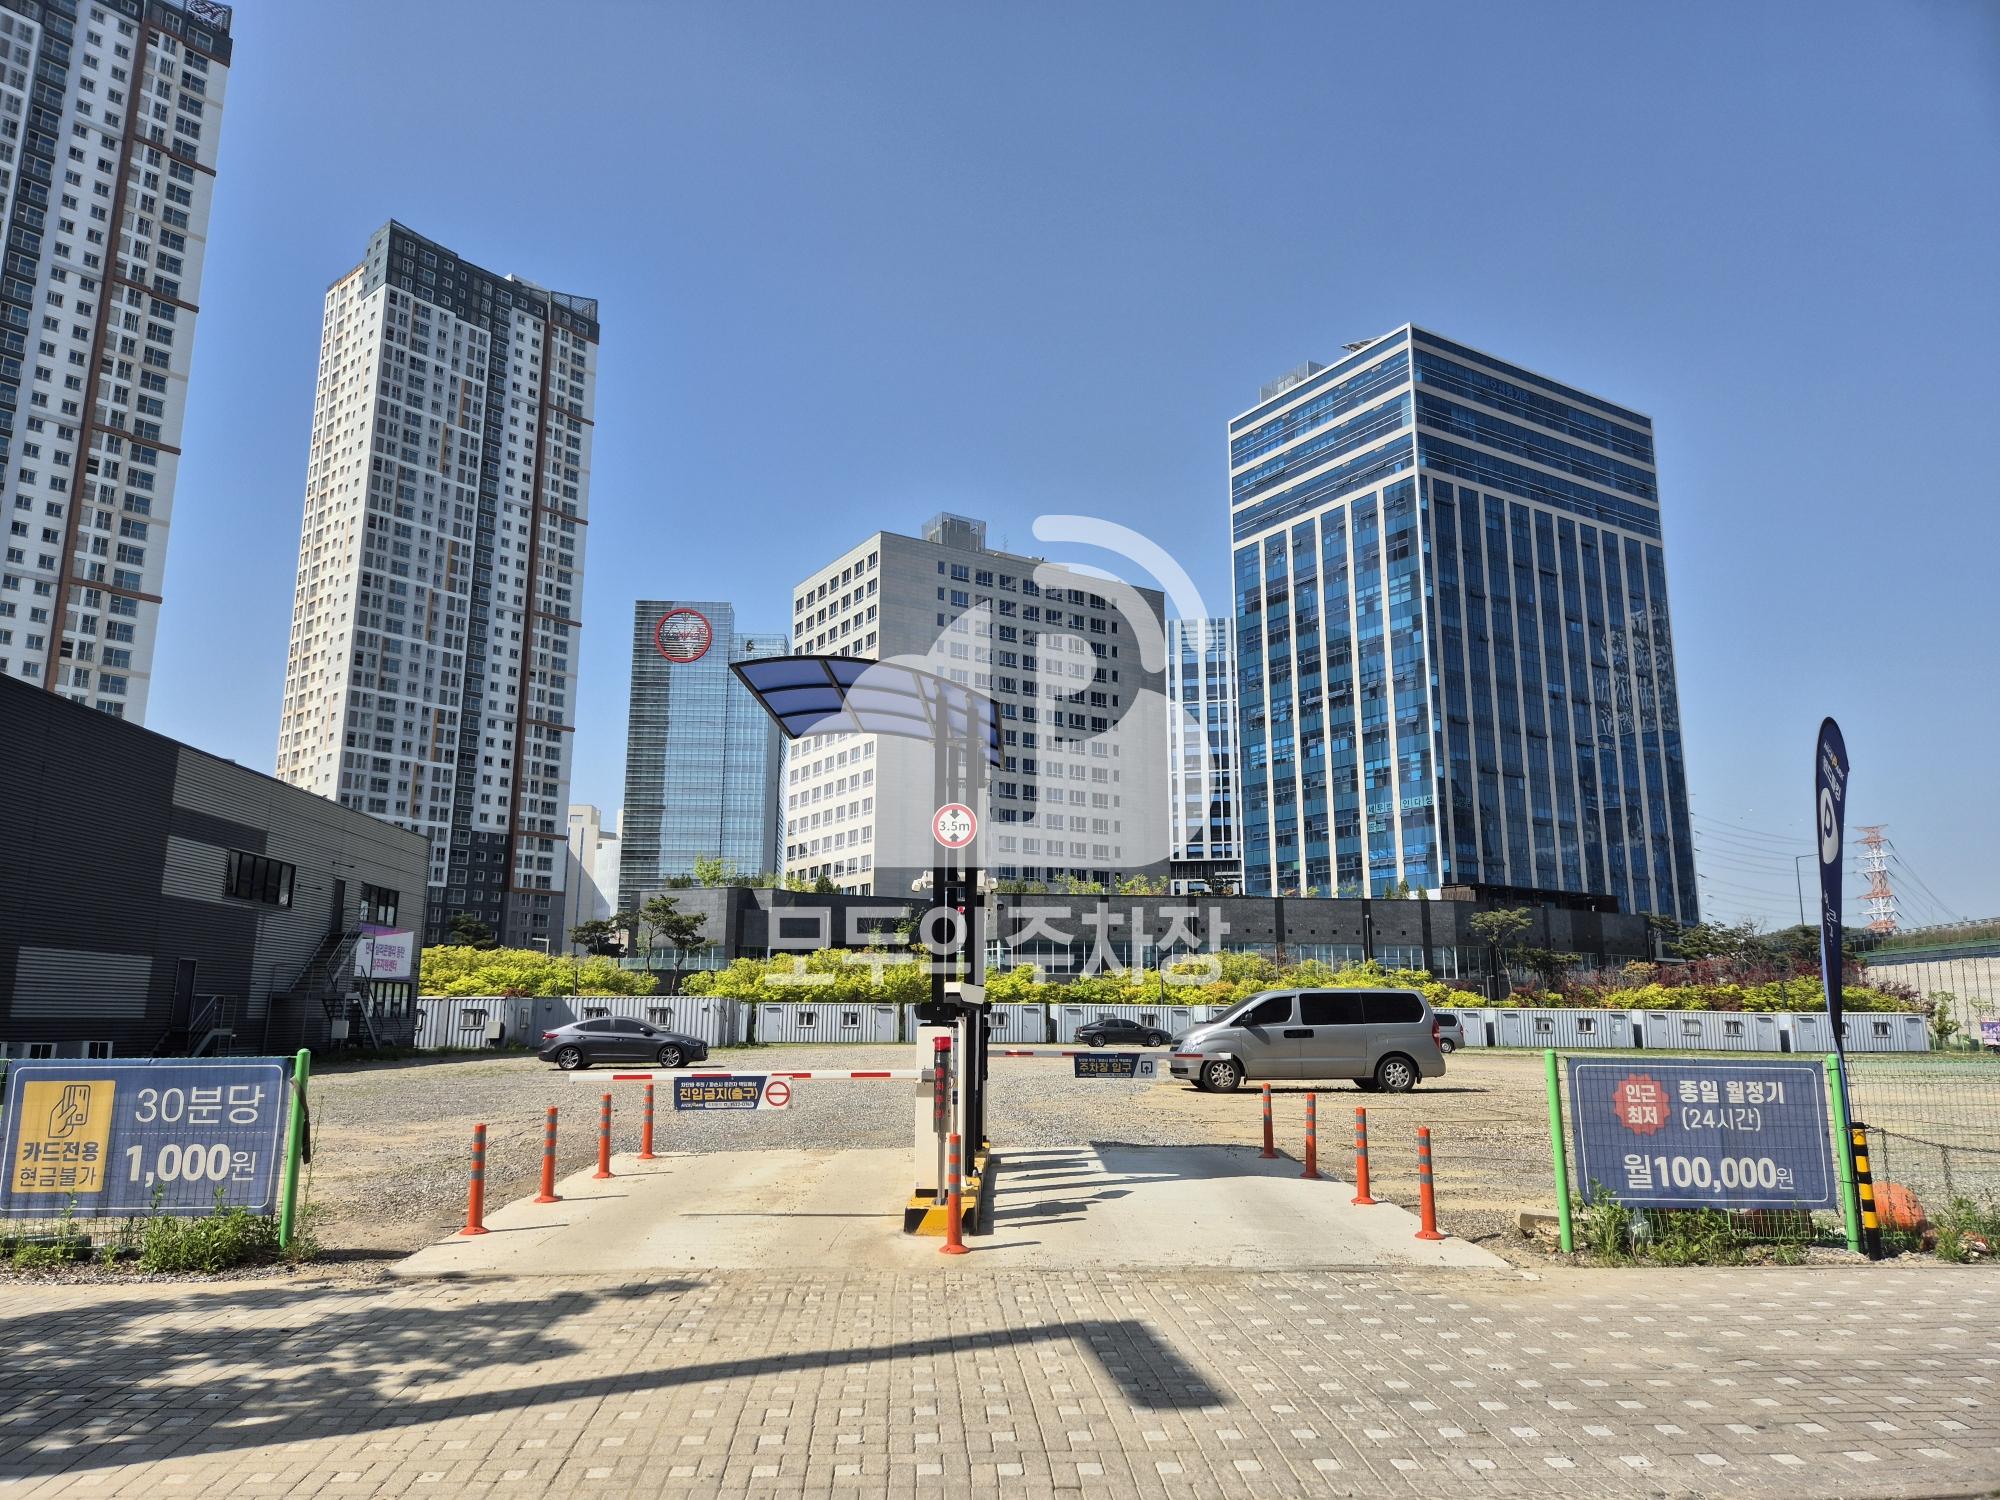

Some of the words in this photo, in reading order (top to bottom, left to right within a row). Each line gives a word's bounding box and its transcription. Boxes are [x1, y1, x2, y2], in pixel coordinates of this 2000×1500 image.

[939, 820, 970, 832] 3.5m
[1079, 1062, 1109, 1073] 주차장
[1112, 1062, 1132, 1073] 입구
[680, 1087, 758, 1101] 진입금지(출구)
[1625, 1083, 1657, 1103] 인근
[1678, 1080, 1720, 1103] 종일
[1725, 1080, 1784, 1104] 월정기
[135, 1085, 265, 1125] 30분당
[1627, 1106, 1658, 1125] 최저
[1681, 1106, 1762, 1132] (24시간)
[22, 1141, 100, 1162] 카드전용
[20, 1166, 97, 1187] 현금불가
[126, 1144, 257, 1188] 1,000원
[1624, 1154, 1795, 1193] 월100,000원
